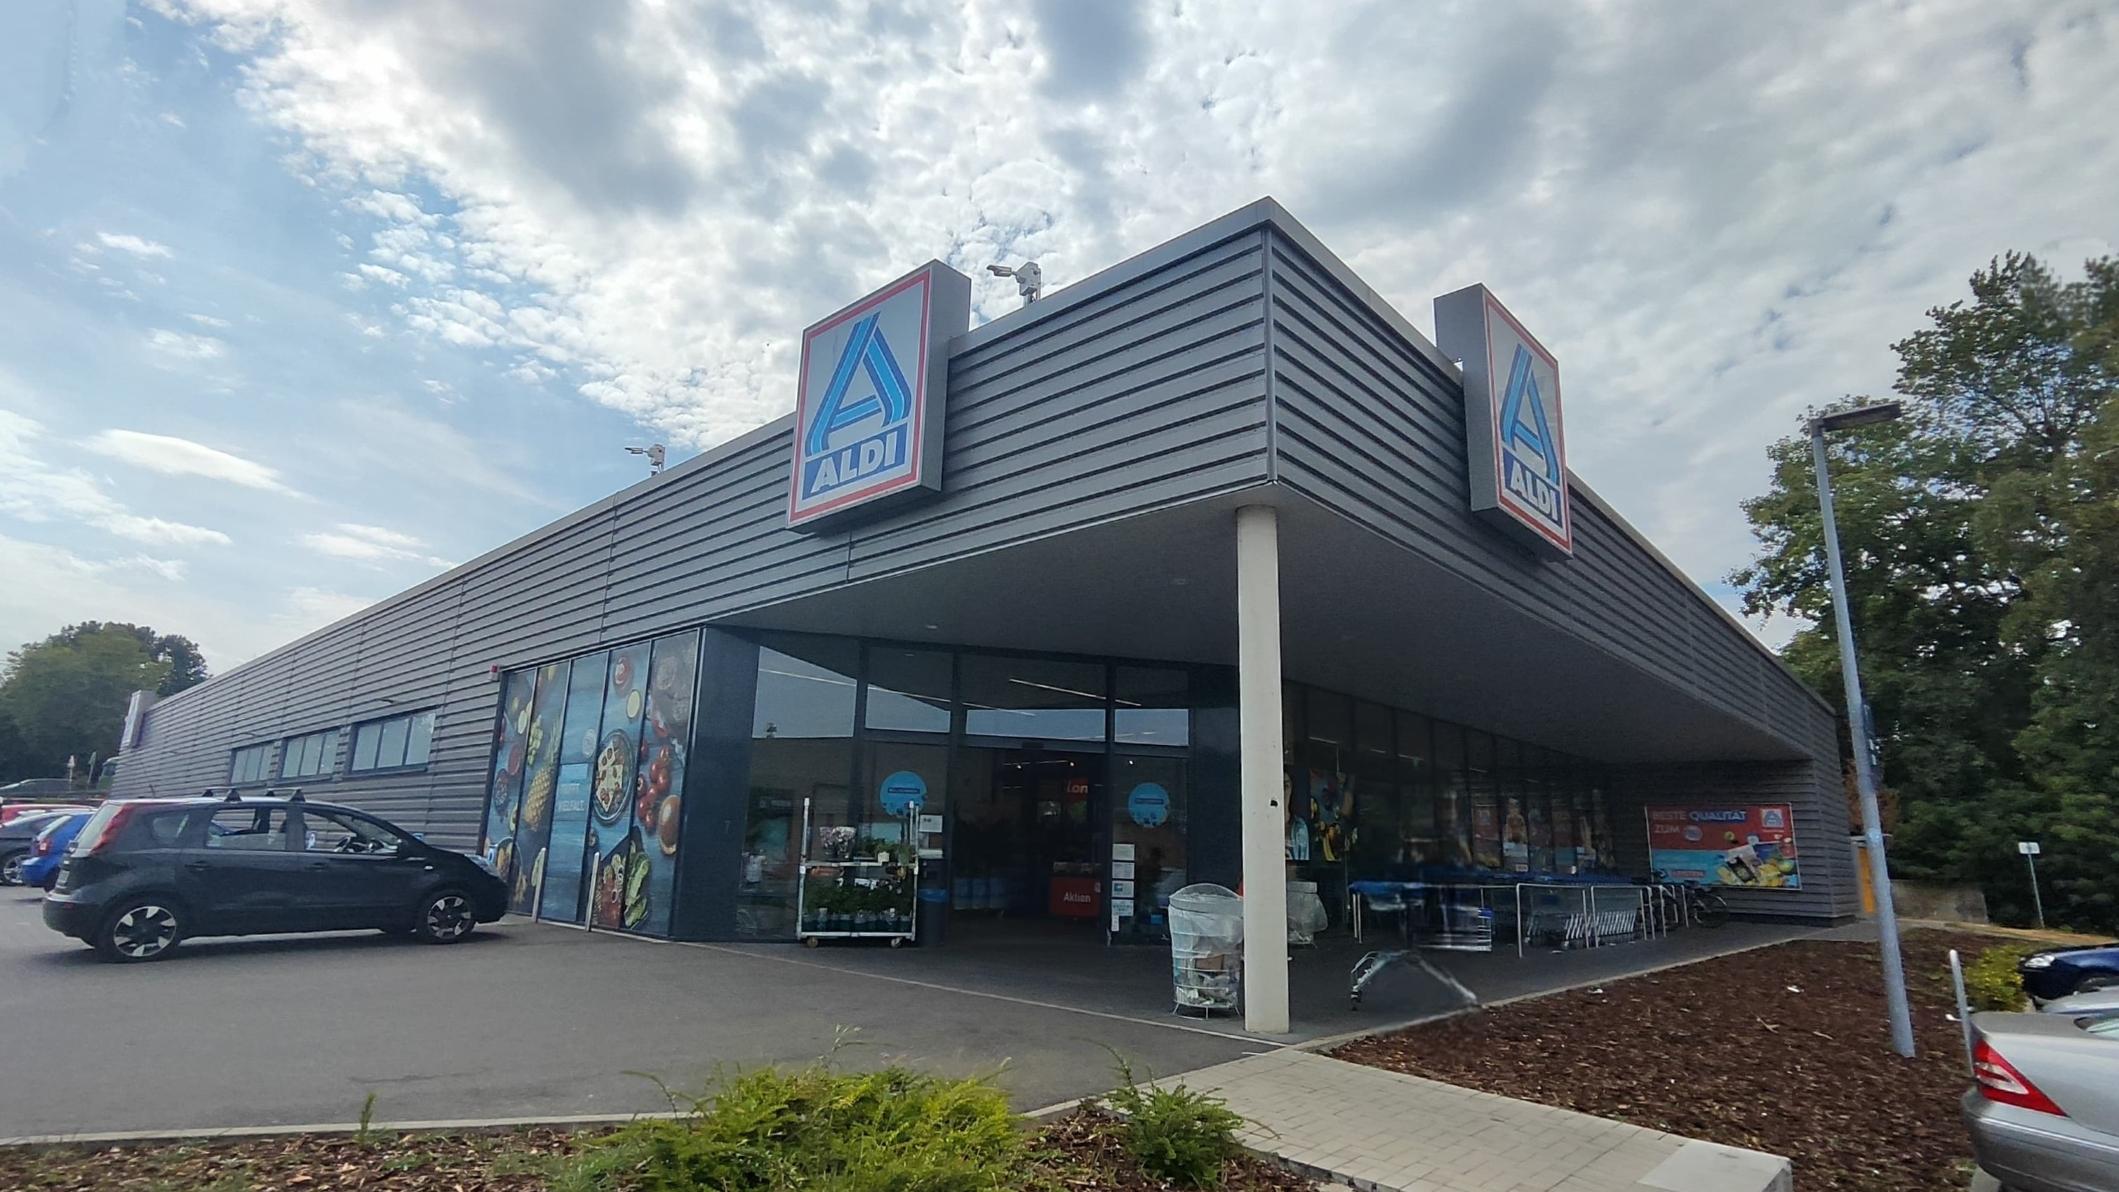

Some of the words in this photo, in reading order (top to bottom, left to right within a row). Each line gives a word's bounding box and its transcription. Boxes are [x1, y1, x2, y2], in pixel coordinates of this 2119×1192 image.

[809, 431, 898, 494] ALDI
[1510, 459, 1559, 522] ALDI
[1063, 891, 1091, 903] Aktion
